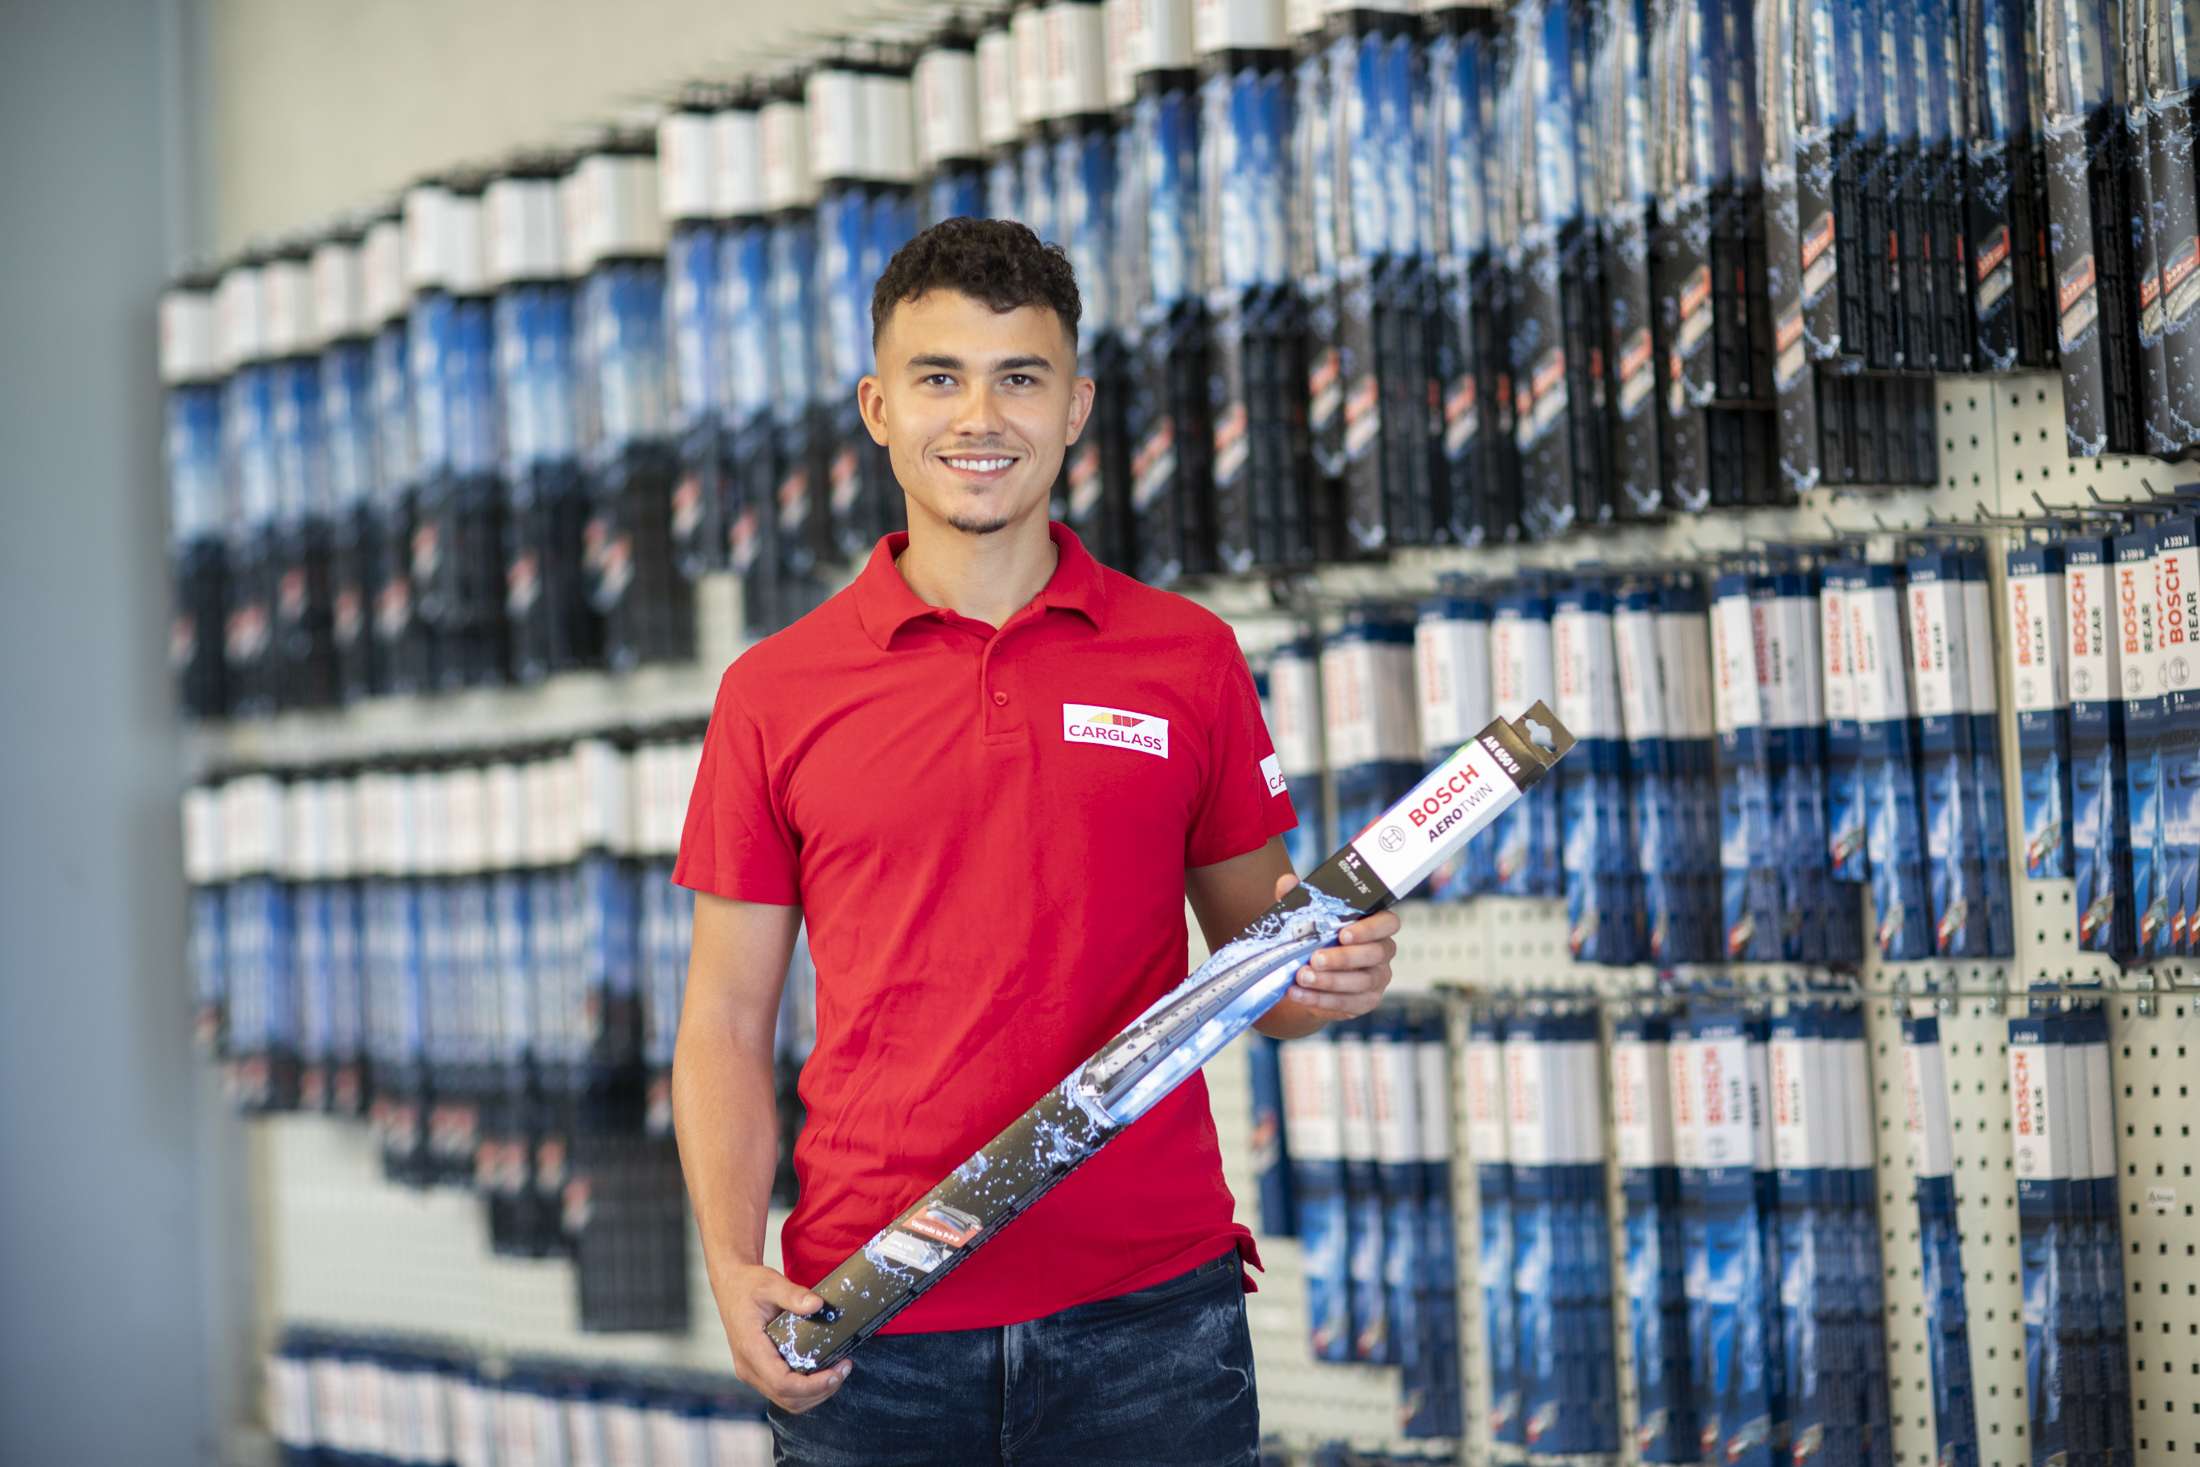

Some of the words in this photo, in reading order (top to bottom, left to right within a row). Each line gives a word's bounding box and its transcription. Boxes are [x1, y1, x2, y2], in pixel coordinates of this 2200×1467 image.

[2014, 583, 2032, 667] BOSCH
[2071, 572, 2088, 656] BOSCH
[2092, 607, 2103, 656] REAR
[2121, 569, 2140, 654] BOSCH
[2142, 604, 2153, 653] REAR
[2165, 557, 2184, 644] BOSCH
[2187, 592, 2200, 642] REAR
[1069, 724, 1162, 751] CARGLASS
[1482, 736, 1500, 752] AR
[1508, 763, 1521, 775] U
[1408, 764, 1480, 828] BOSCH
[2015, 1052, 2032, 1136] BOSCH
